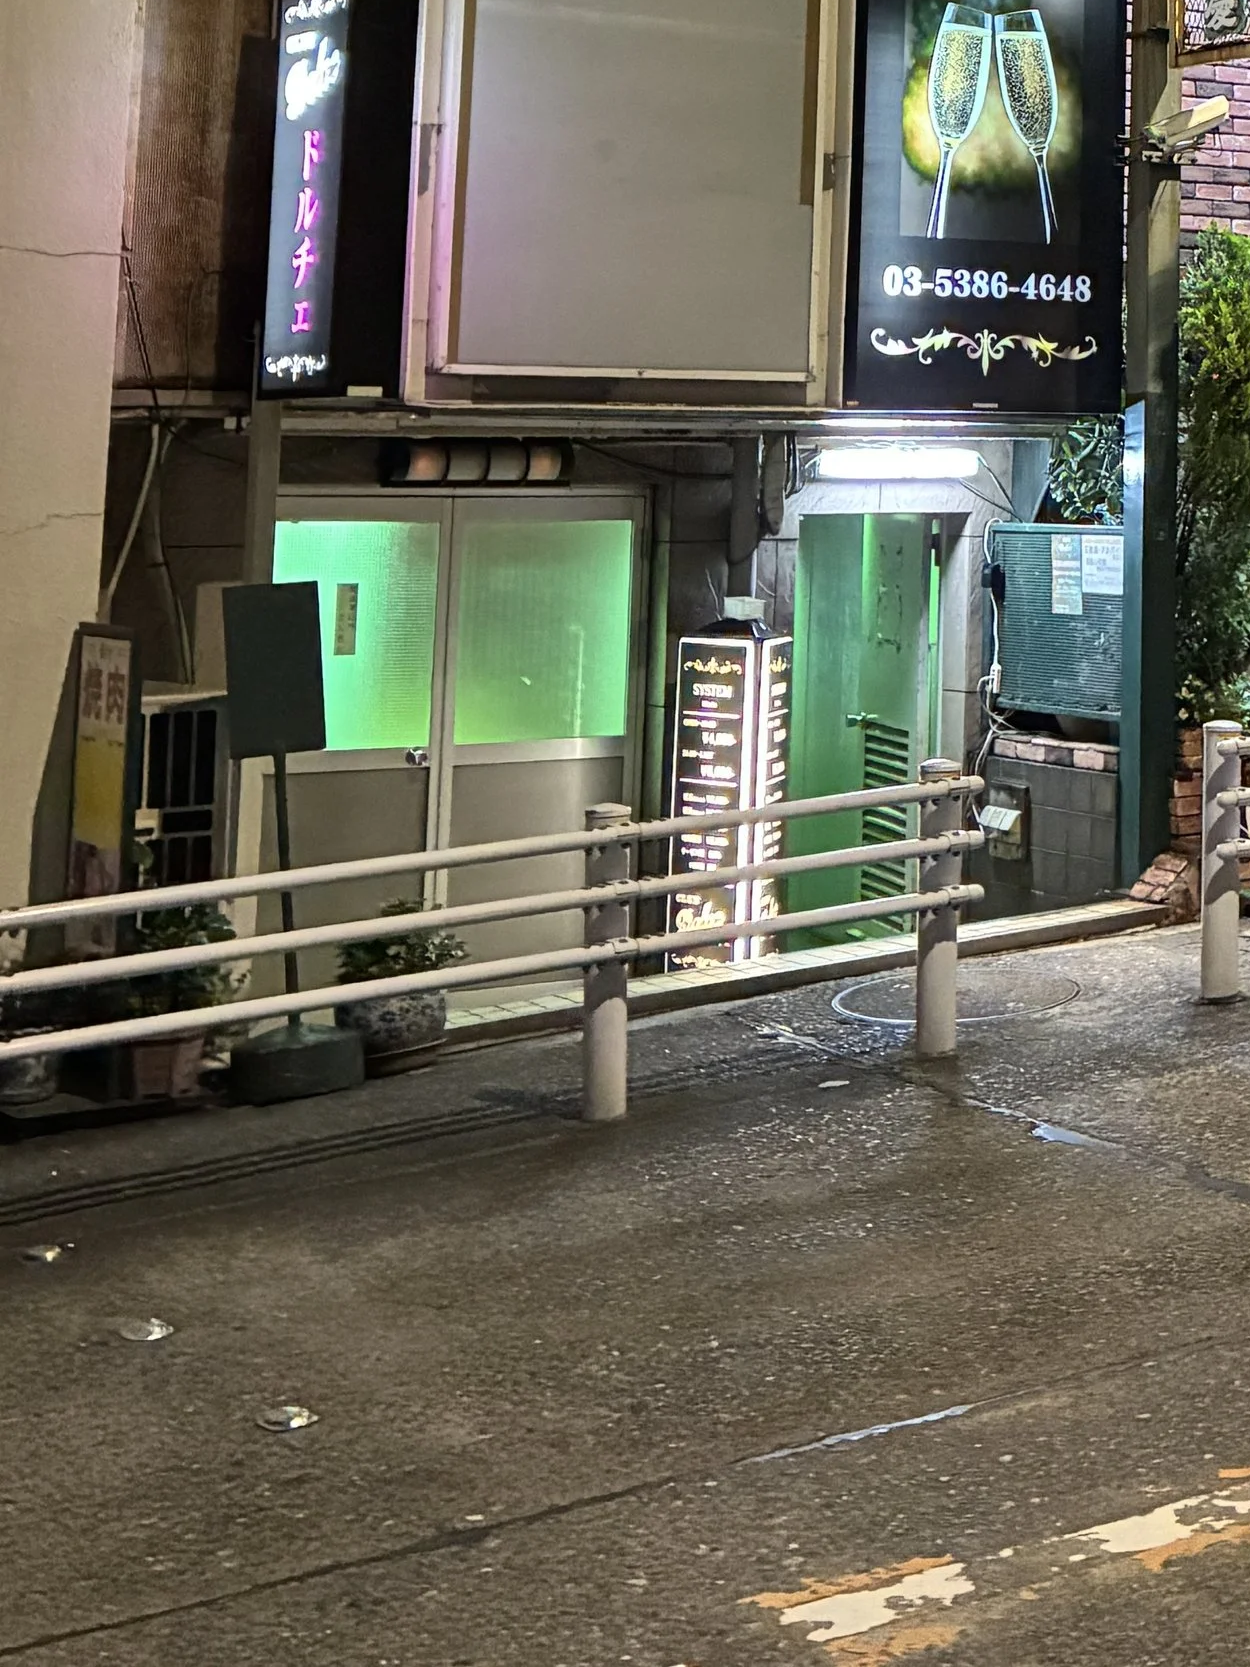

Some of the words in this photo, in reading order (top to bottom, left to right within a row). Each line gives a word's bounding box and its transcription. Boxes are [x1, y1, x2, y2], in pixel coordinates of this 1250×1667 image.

[290, 127, 324, 336] ドルチェ
[881, 264, 1093, 305] 03-5386-4648
